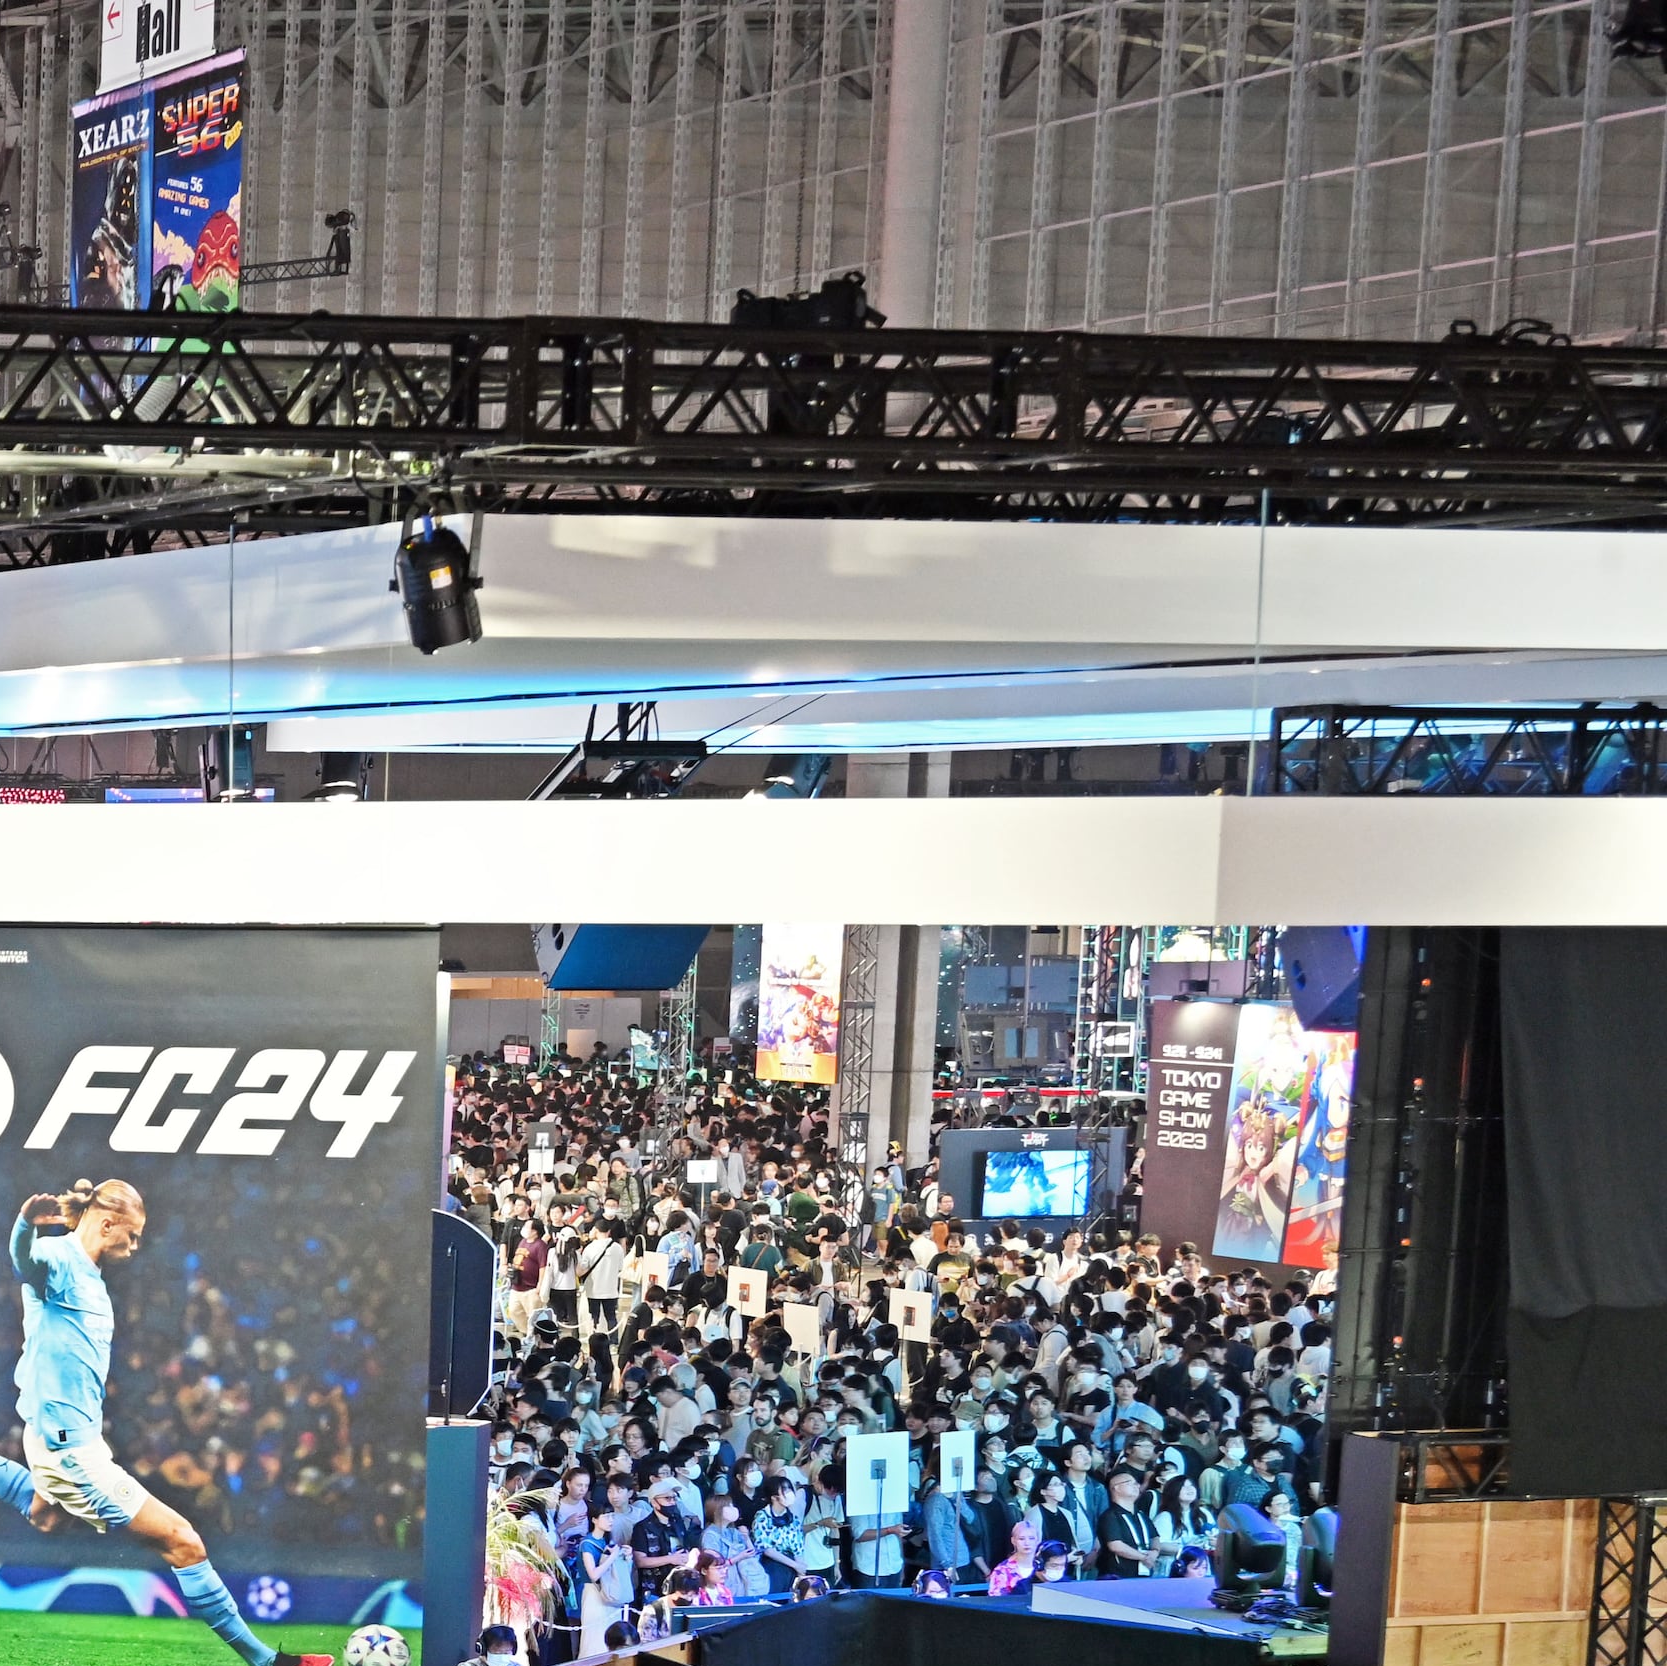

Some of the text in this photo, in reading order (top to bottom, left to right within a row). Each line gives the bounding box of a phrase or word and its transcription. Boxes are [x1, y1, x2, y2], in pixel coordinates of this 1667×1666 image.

[162, 80, 240, 133] SUPER
[190, 176, 203, 194] 56
[158, 188, 210, 209] AMAZING GAMES
[1160, 1068, 1221, 1090] TOKYO
[1159, 1089, 1212, 1109] GAME
[1158, 1109, 1212, 1129] SHOW
[1157, 1130, 1207, 1150] 2023
